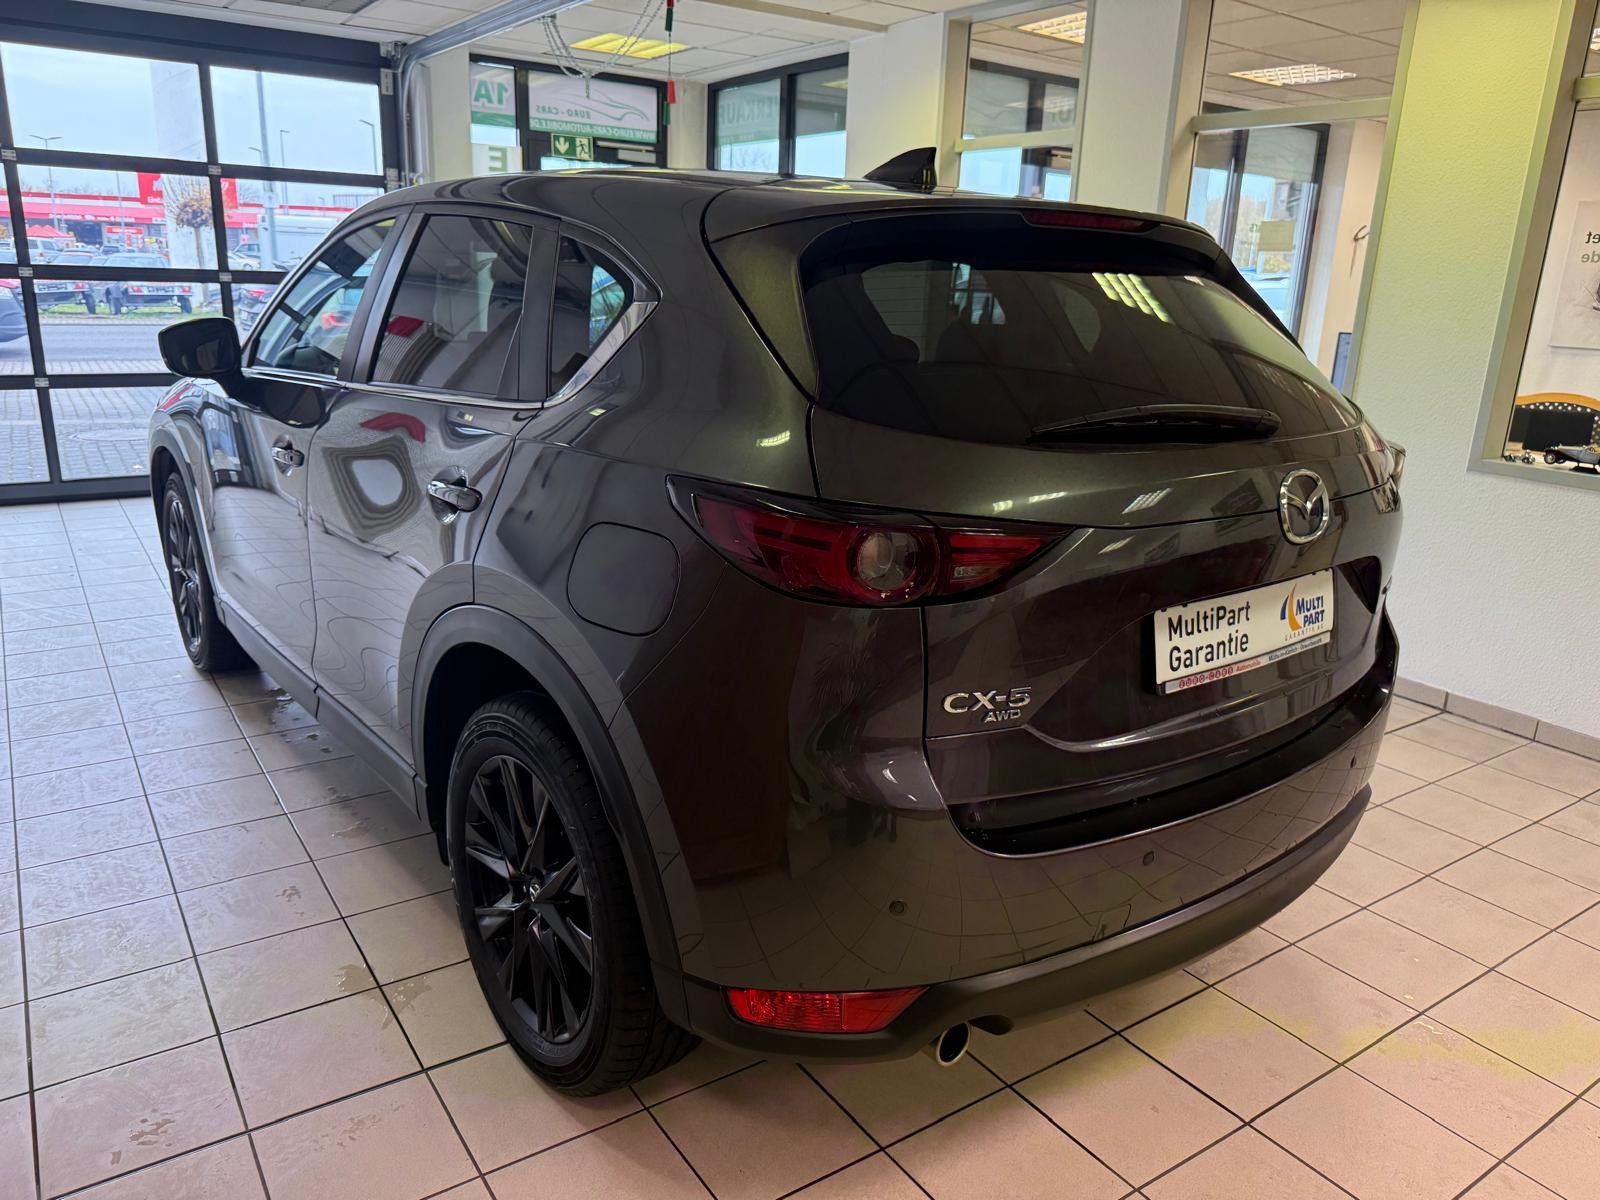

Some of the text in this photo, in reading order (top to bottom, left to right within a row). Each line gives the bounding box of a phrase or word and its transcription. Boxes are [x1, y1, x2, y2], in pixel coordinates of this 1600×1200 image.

[1296, 595, 1324, 614] MULTI
[1168, 601, 1250, 641] MultiPart
[1303, 609, 1325, 628] PART
[1169, 630, 1249, 672] Garantie
[943, 686, 1032, 714] CX-5
[984, 708, 1021, 723] AWD
